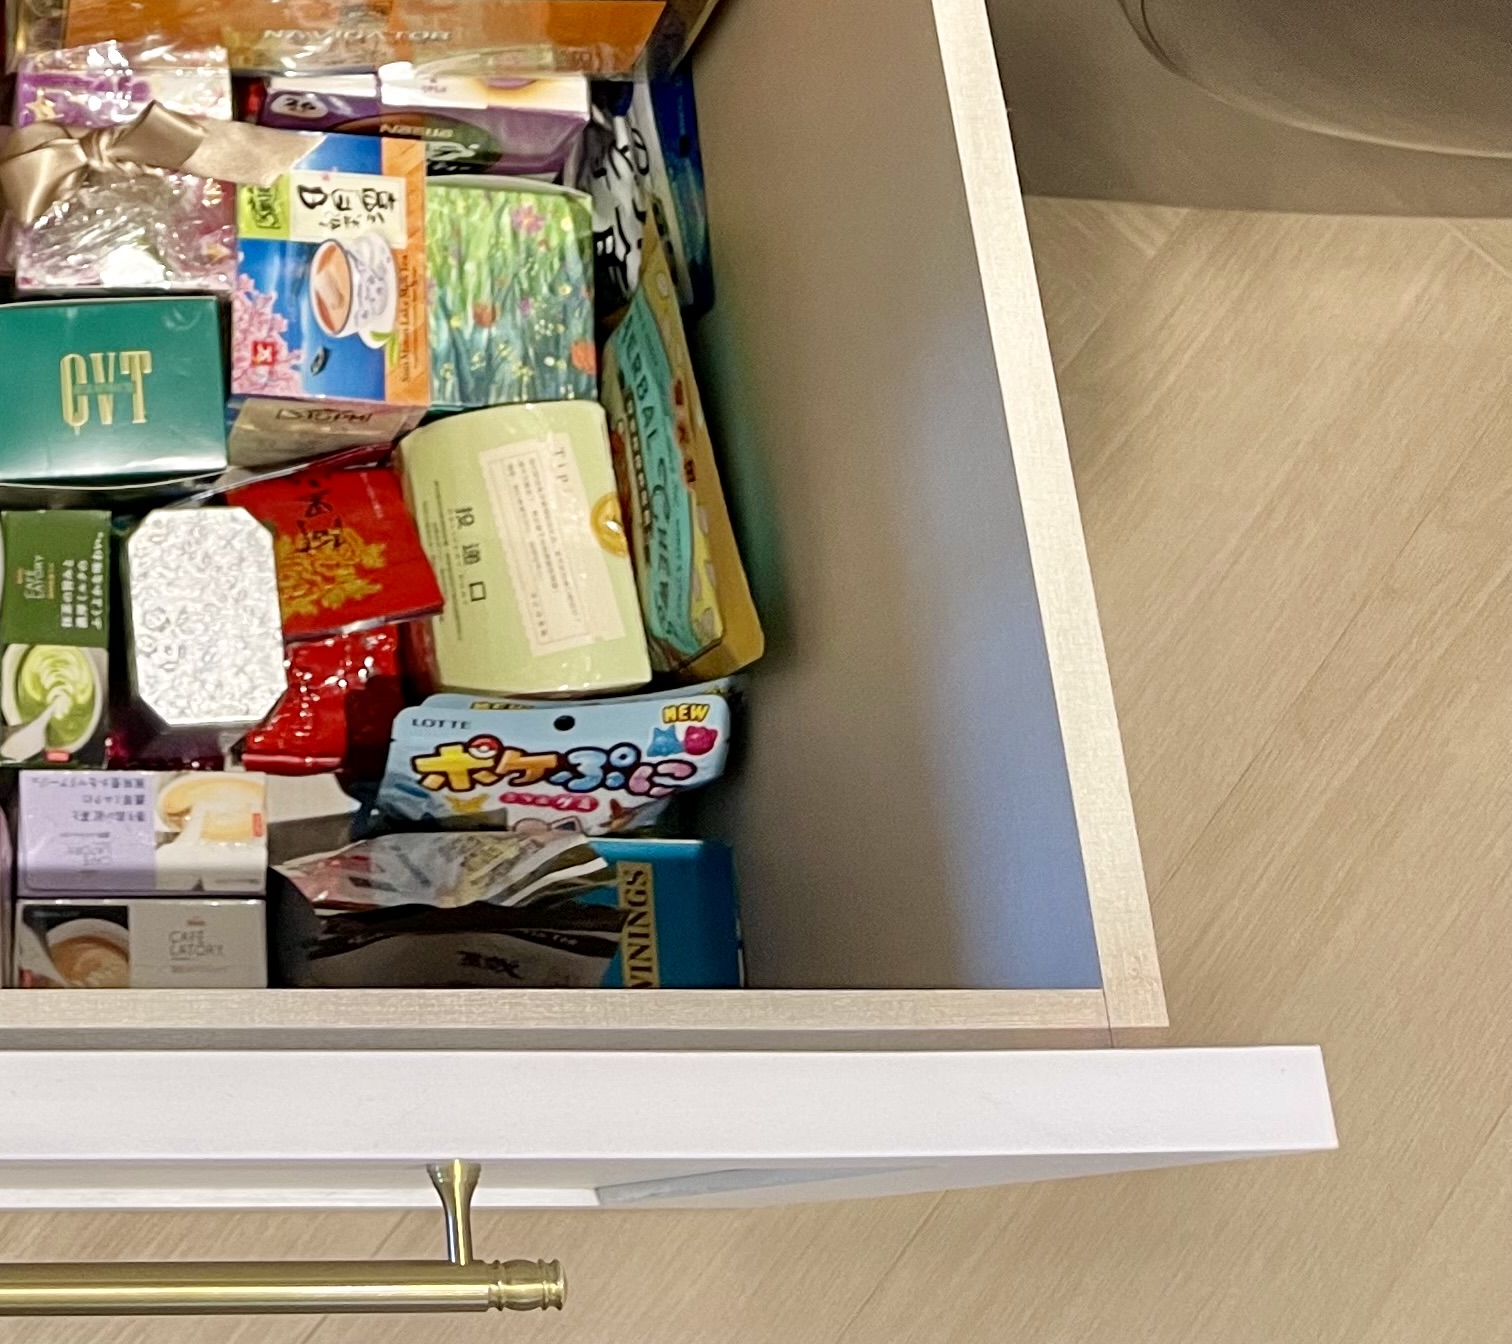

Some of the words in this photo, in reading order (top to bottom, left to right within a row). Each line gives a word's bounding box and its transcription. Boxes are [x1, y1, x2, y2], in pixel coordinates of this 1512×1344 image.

[60, 350, 153, 427] CVT
[411, 717, 471, 730] LOTTE
[662, 703, 710, 724] NEW
[410, 736, 698, 797] ポケぷに
